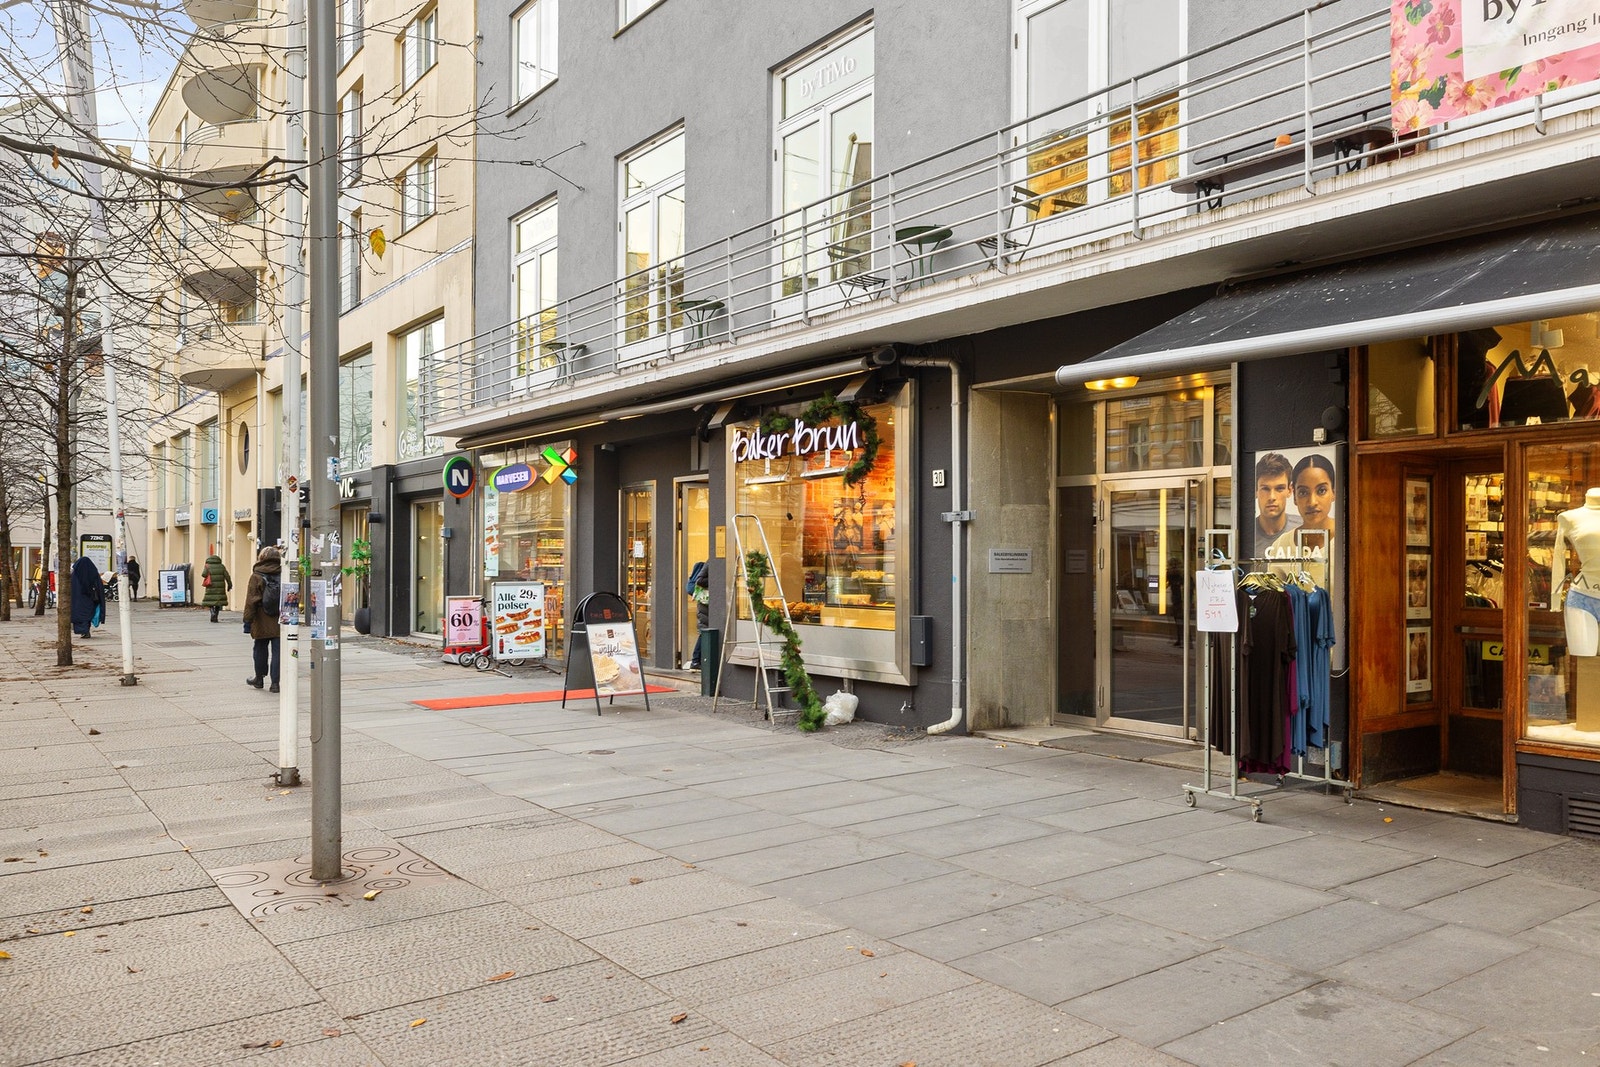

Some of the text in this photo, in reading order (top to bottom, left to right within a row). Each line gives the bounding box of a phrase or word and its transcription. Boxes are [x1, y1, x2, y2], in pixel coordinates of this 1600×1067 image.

[1523, 18, 1588, 46] Inngang
[730, 418, 858, 463] Baker Brun
[452, 468, 469, 487] N
[934, 471, 943, 484] 30
[497, 592, 517, 602] Alle
[497, 602, 529, 612] pølser
[450, 612, 473, 628] 60
